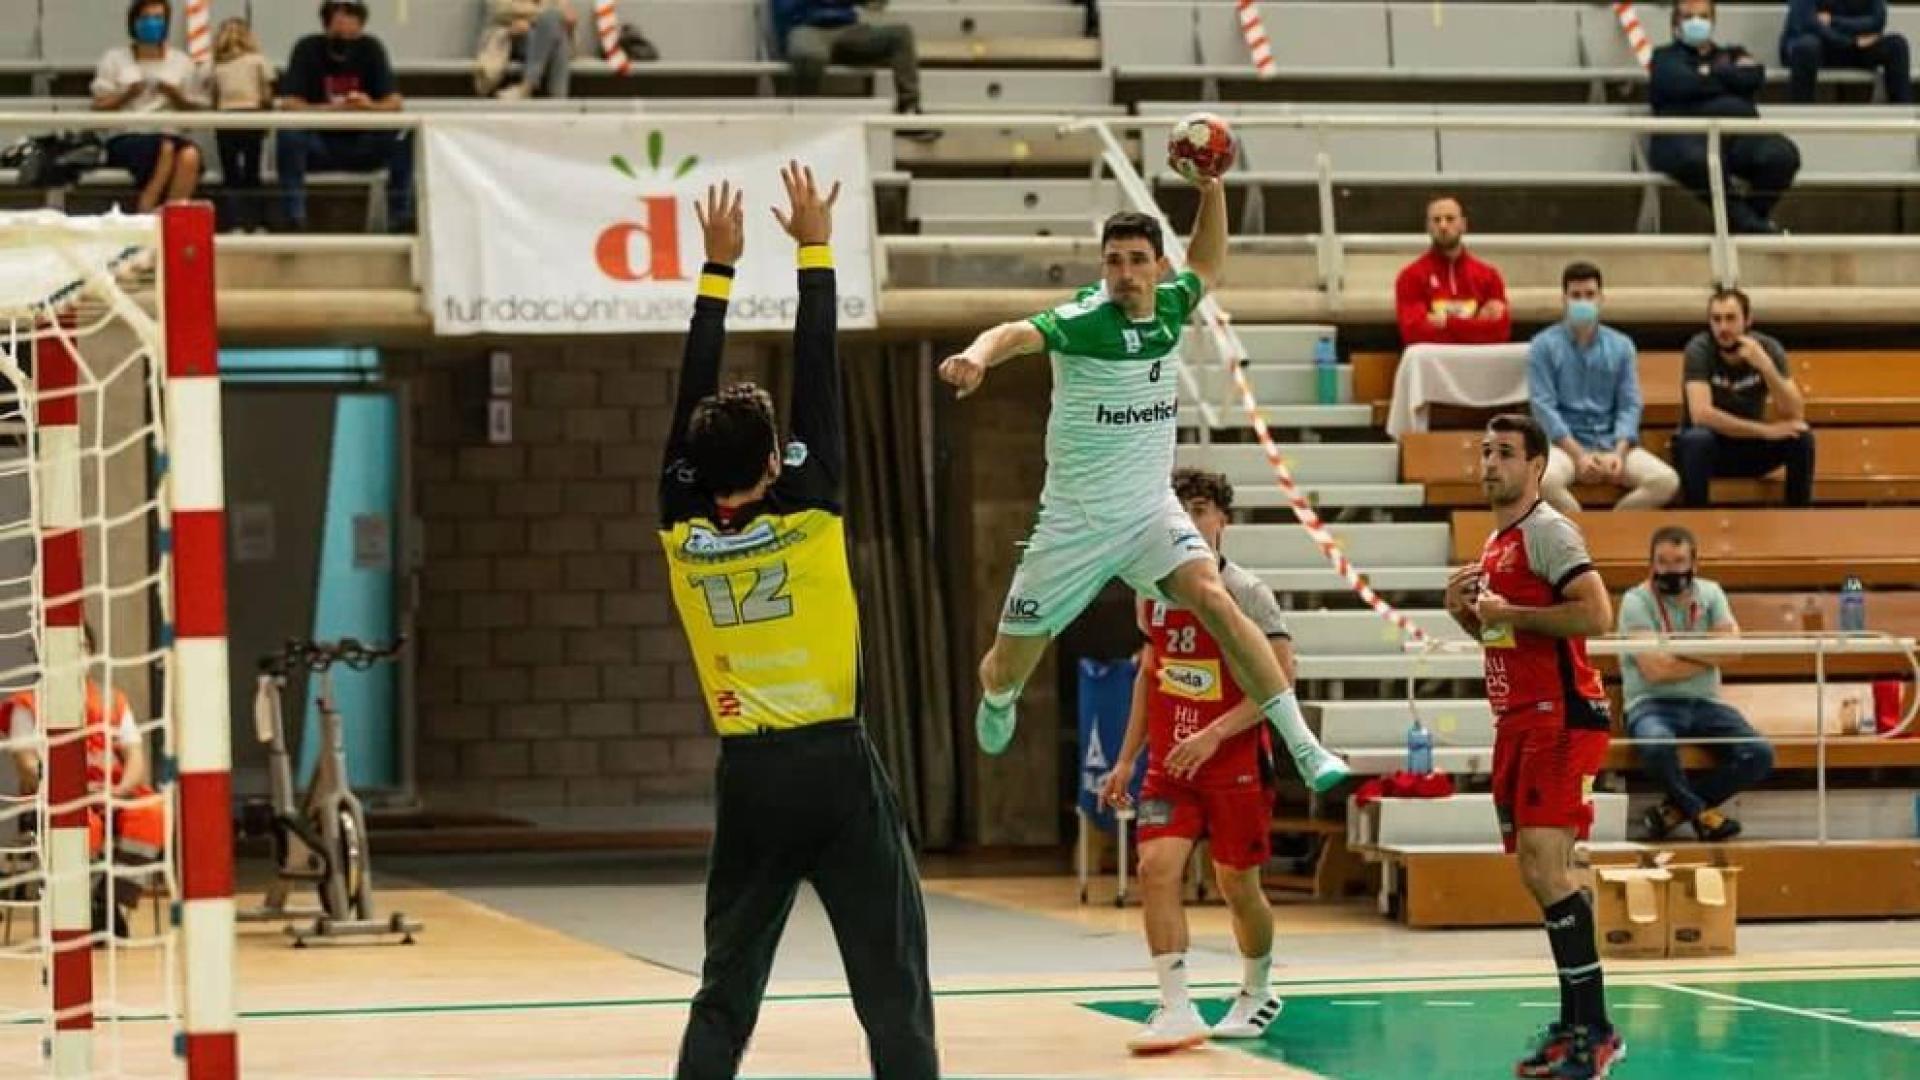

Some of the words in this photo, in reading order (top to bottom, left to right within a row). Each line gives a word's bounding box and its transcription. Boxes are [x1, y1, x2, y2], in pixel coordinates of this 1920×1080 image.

[595, 196, 692, 281] d
[687, 560, 793, 627] 12
[1166, 626, 1196, 653] 28
